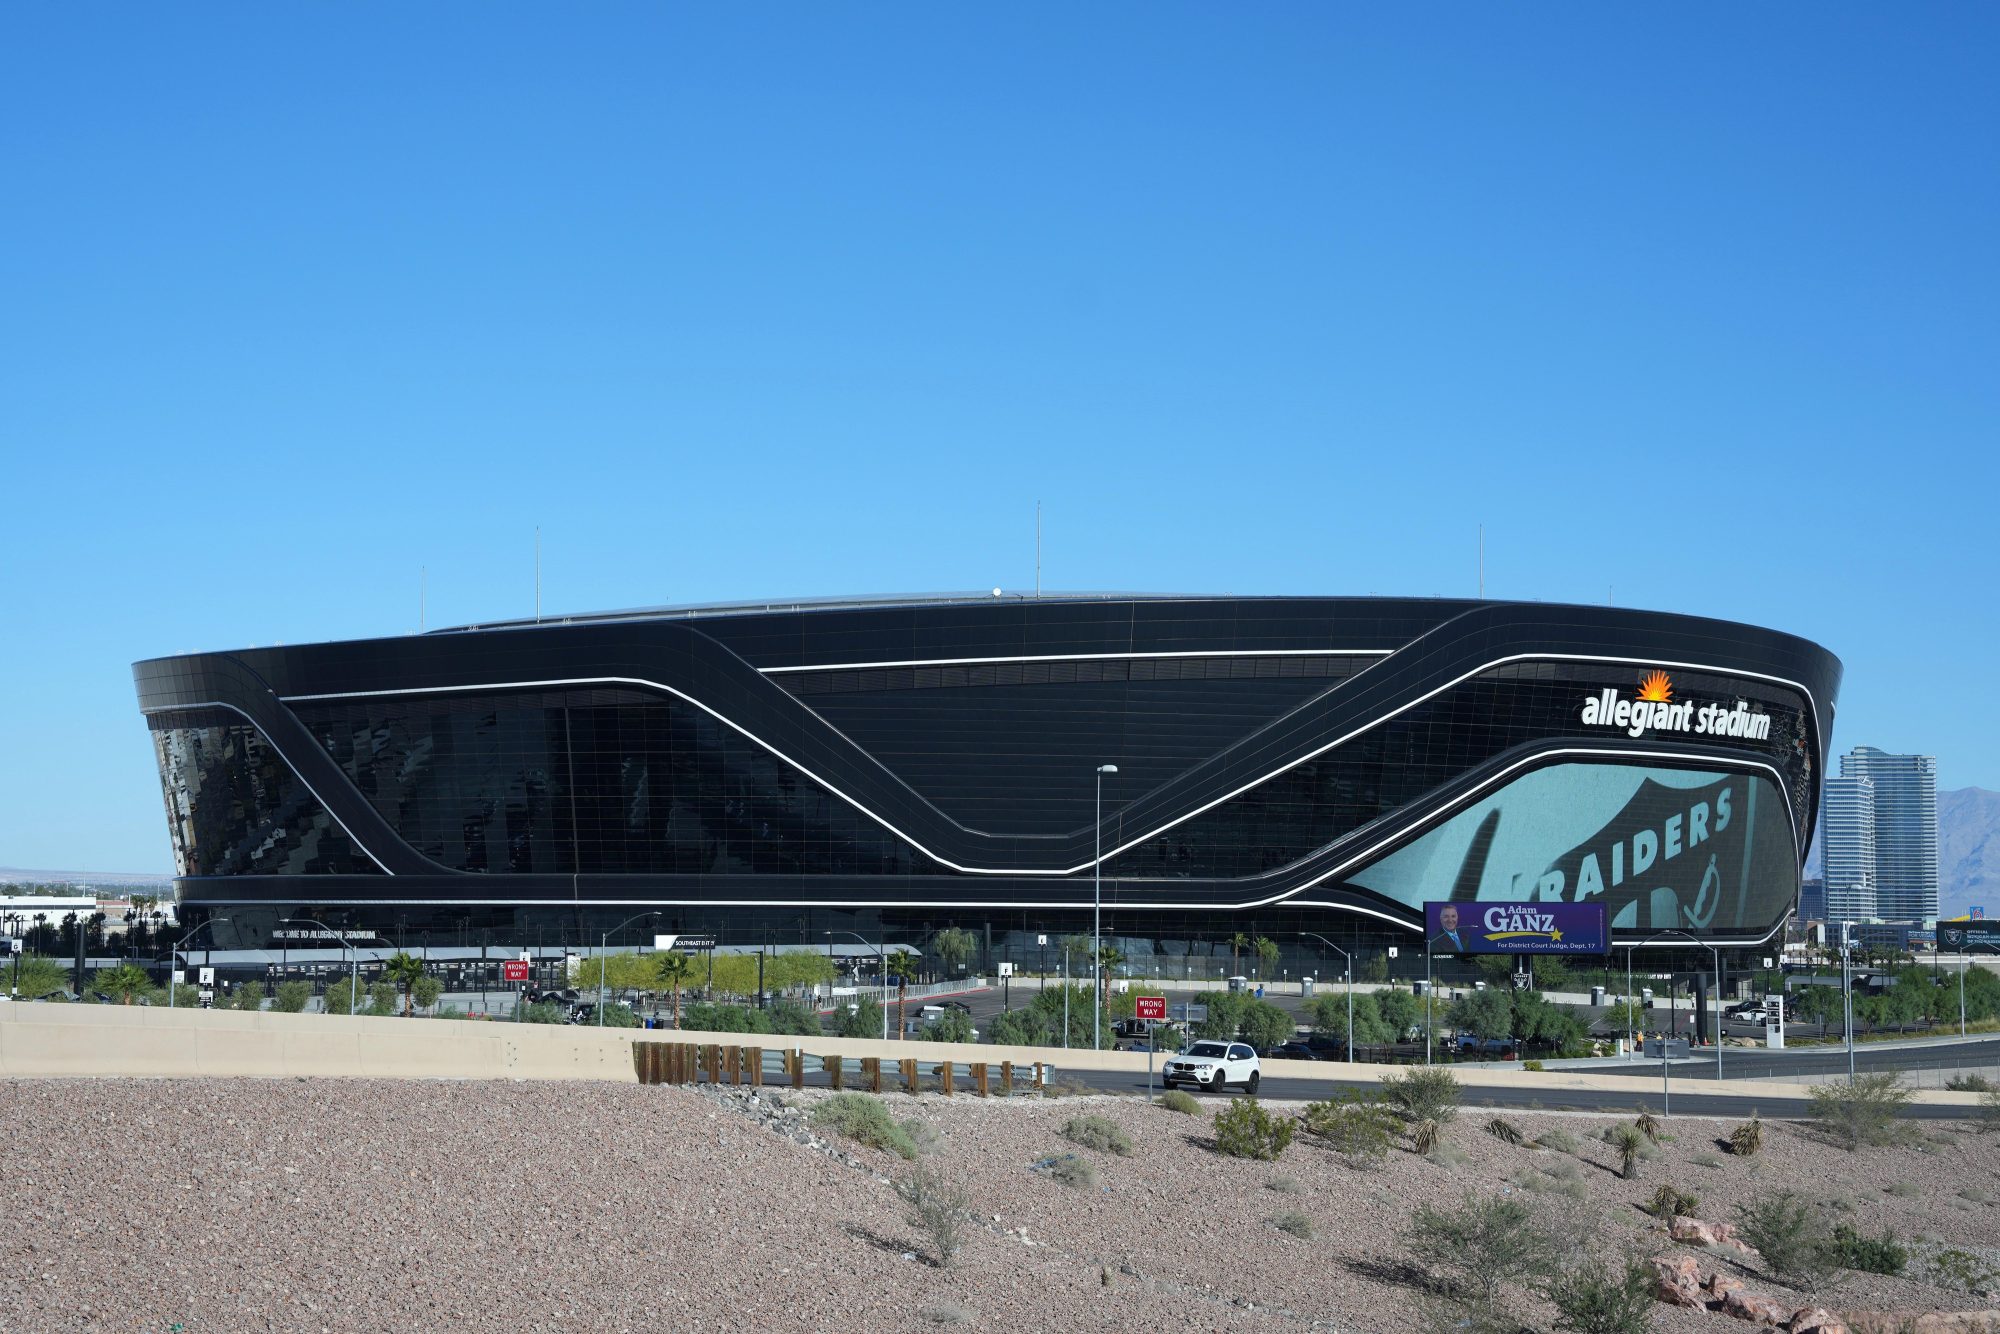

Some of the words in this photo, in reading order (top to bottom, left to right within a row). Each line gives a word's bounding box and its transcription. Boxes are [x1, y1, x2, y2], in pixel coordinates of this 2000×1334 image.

[1581, 688, 1694, 738] allegiant
[1694, 700, 1771, 740] stadium
[1539, 787, 1732, 902] RAIDERS
[1483, 906, 1555, 932] GANZ
[1507, 905, 1537, 914] Adam
[272, 930, 299, 939] WELOME
[344, 930, 376, 940] STADIUM
